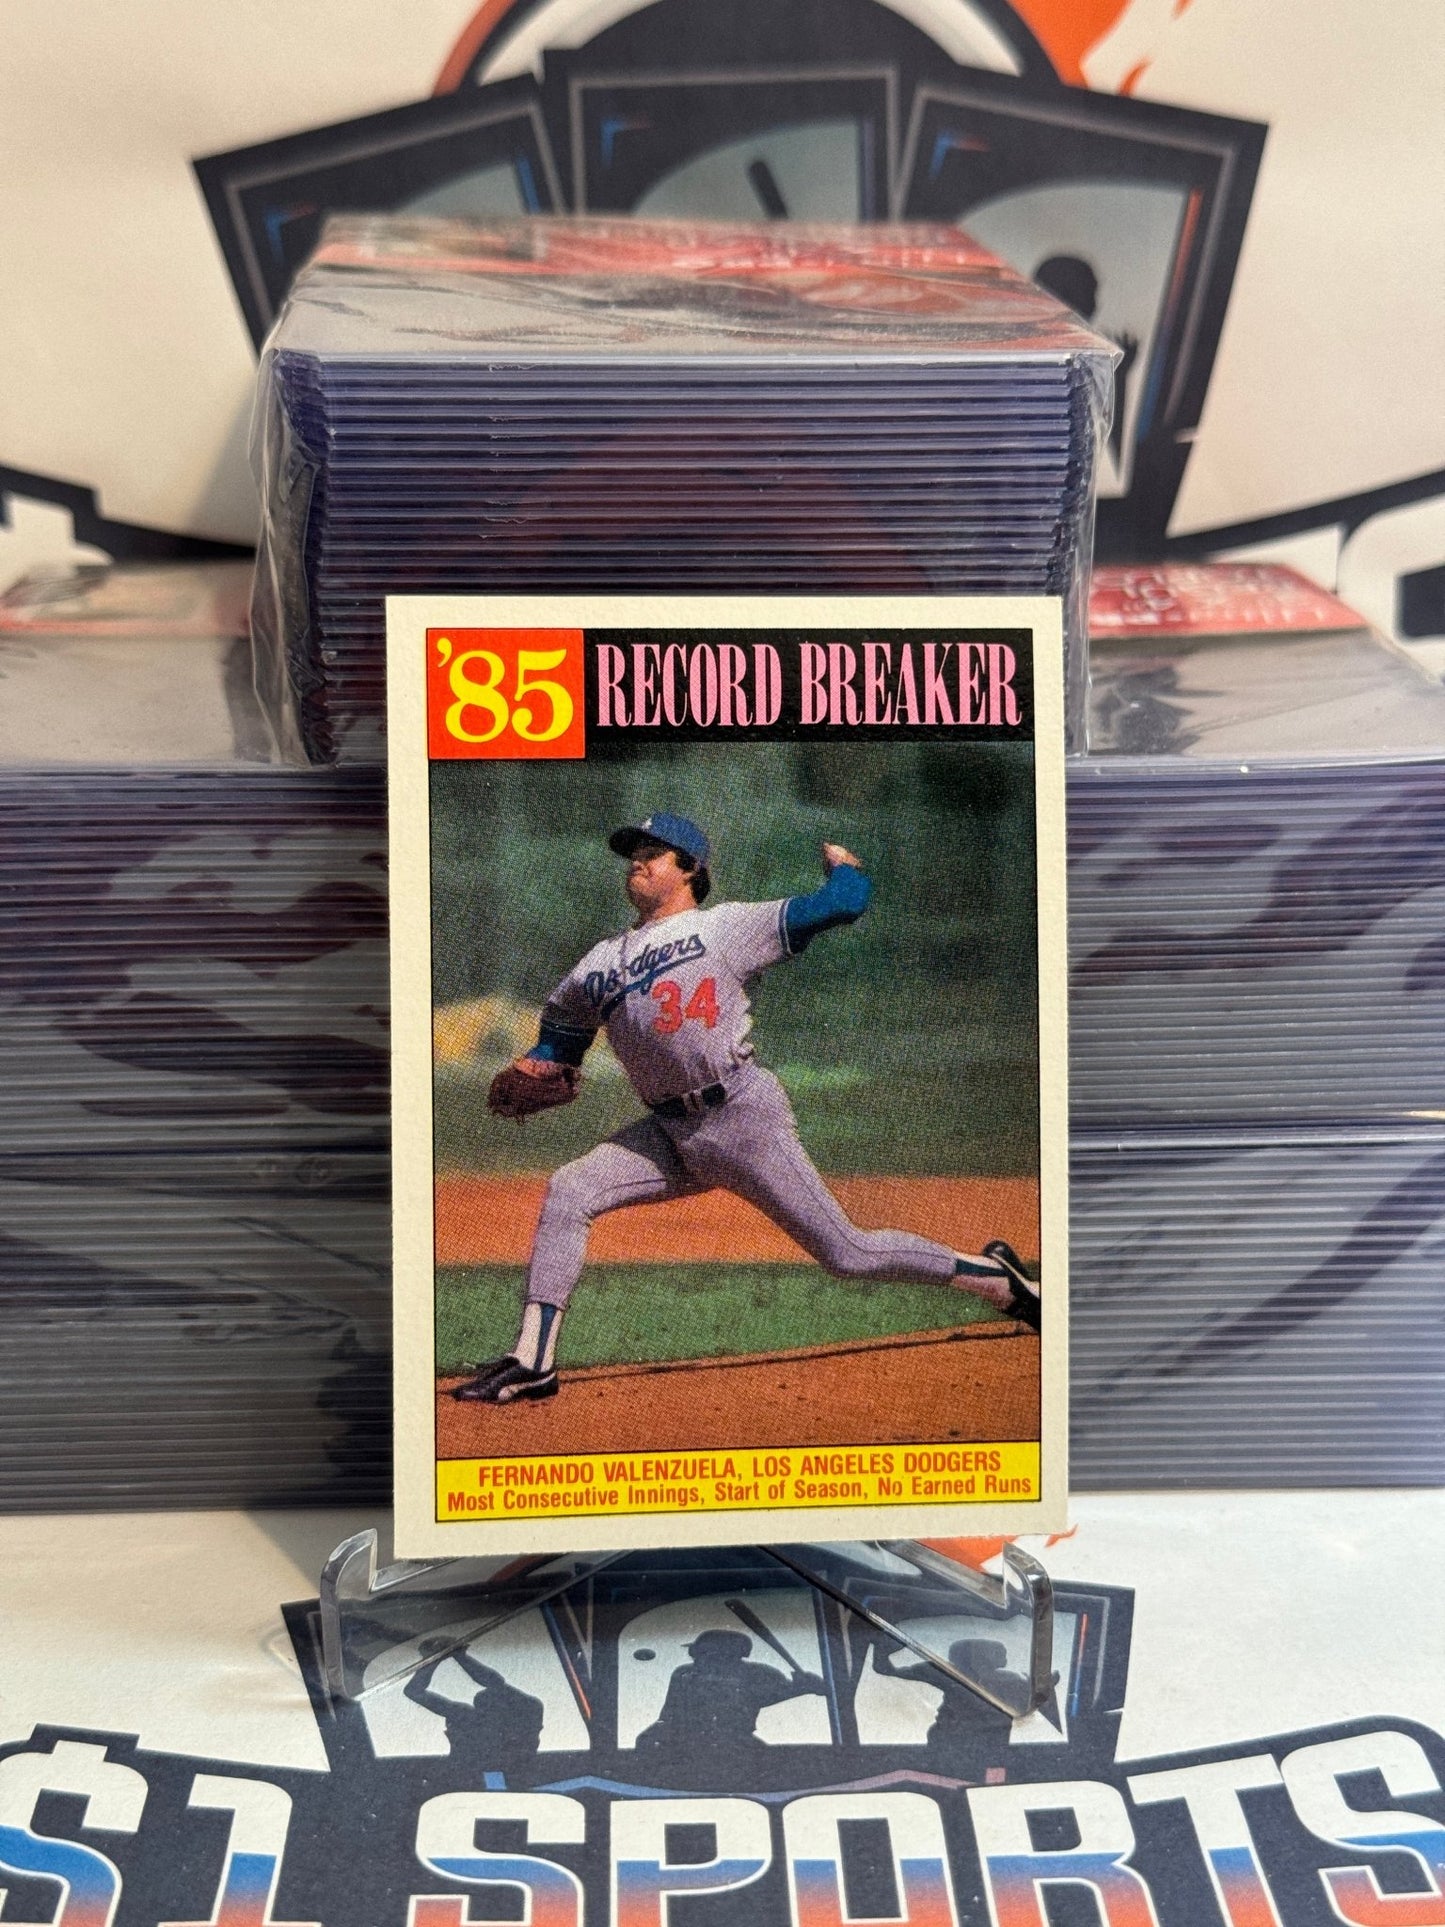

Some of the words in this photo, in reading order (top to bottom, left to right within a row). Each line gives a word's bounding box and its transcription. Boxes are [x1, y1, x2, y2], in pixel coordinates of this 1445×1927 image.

[436, 638, 575, 744] '85
[596, 643, 783, 728] RECORD
[799, 641, 1023, 727] BREAKER
[651, 977, 720, 1034] 34
[448, 1491, 496, 1512] Most
[503, 1486, 619, 1510] Consecutive
[628, 1484, 706, 1507] Innings,
[714, 1480, 760, 1502] Start
[768, 1479, 786, 1500] of
[794, 1477, 869, 1500] Season,
[877, 1477, 904, 1497] No
[911, 1475, 976, 1496] Earned
[984, 1473, 1032, 1494] Runs
[478, 1464, 595, 1487] FERNANDO
[603, 1458, 743, 1484] VALENZUELA,
[752, 1455, 792, 1478] LOS
[800, 1452, 895, 1477] ANGELES
[903, 1450, 1002, 1474] DODGERS
[407, 1730, 1445, 1927] SPORTS
